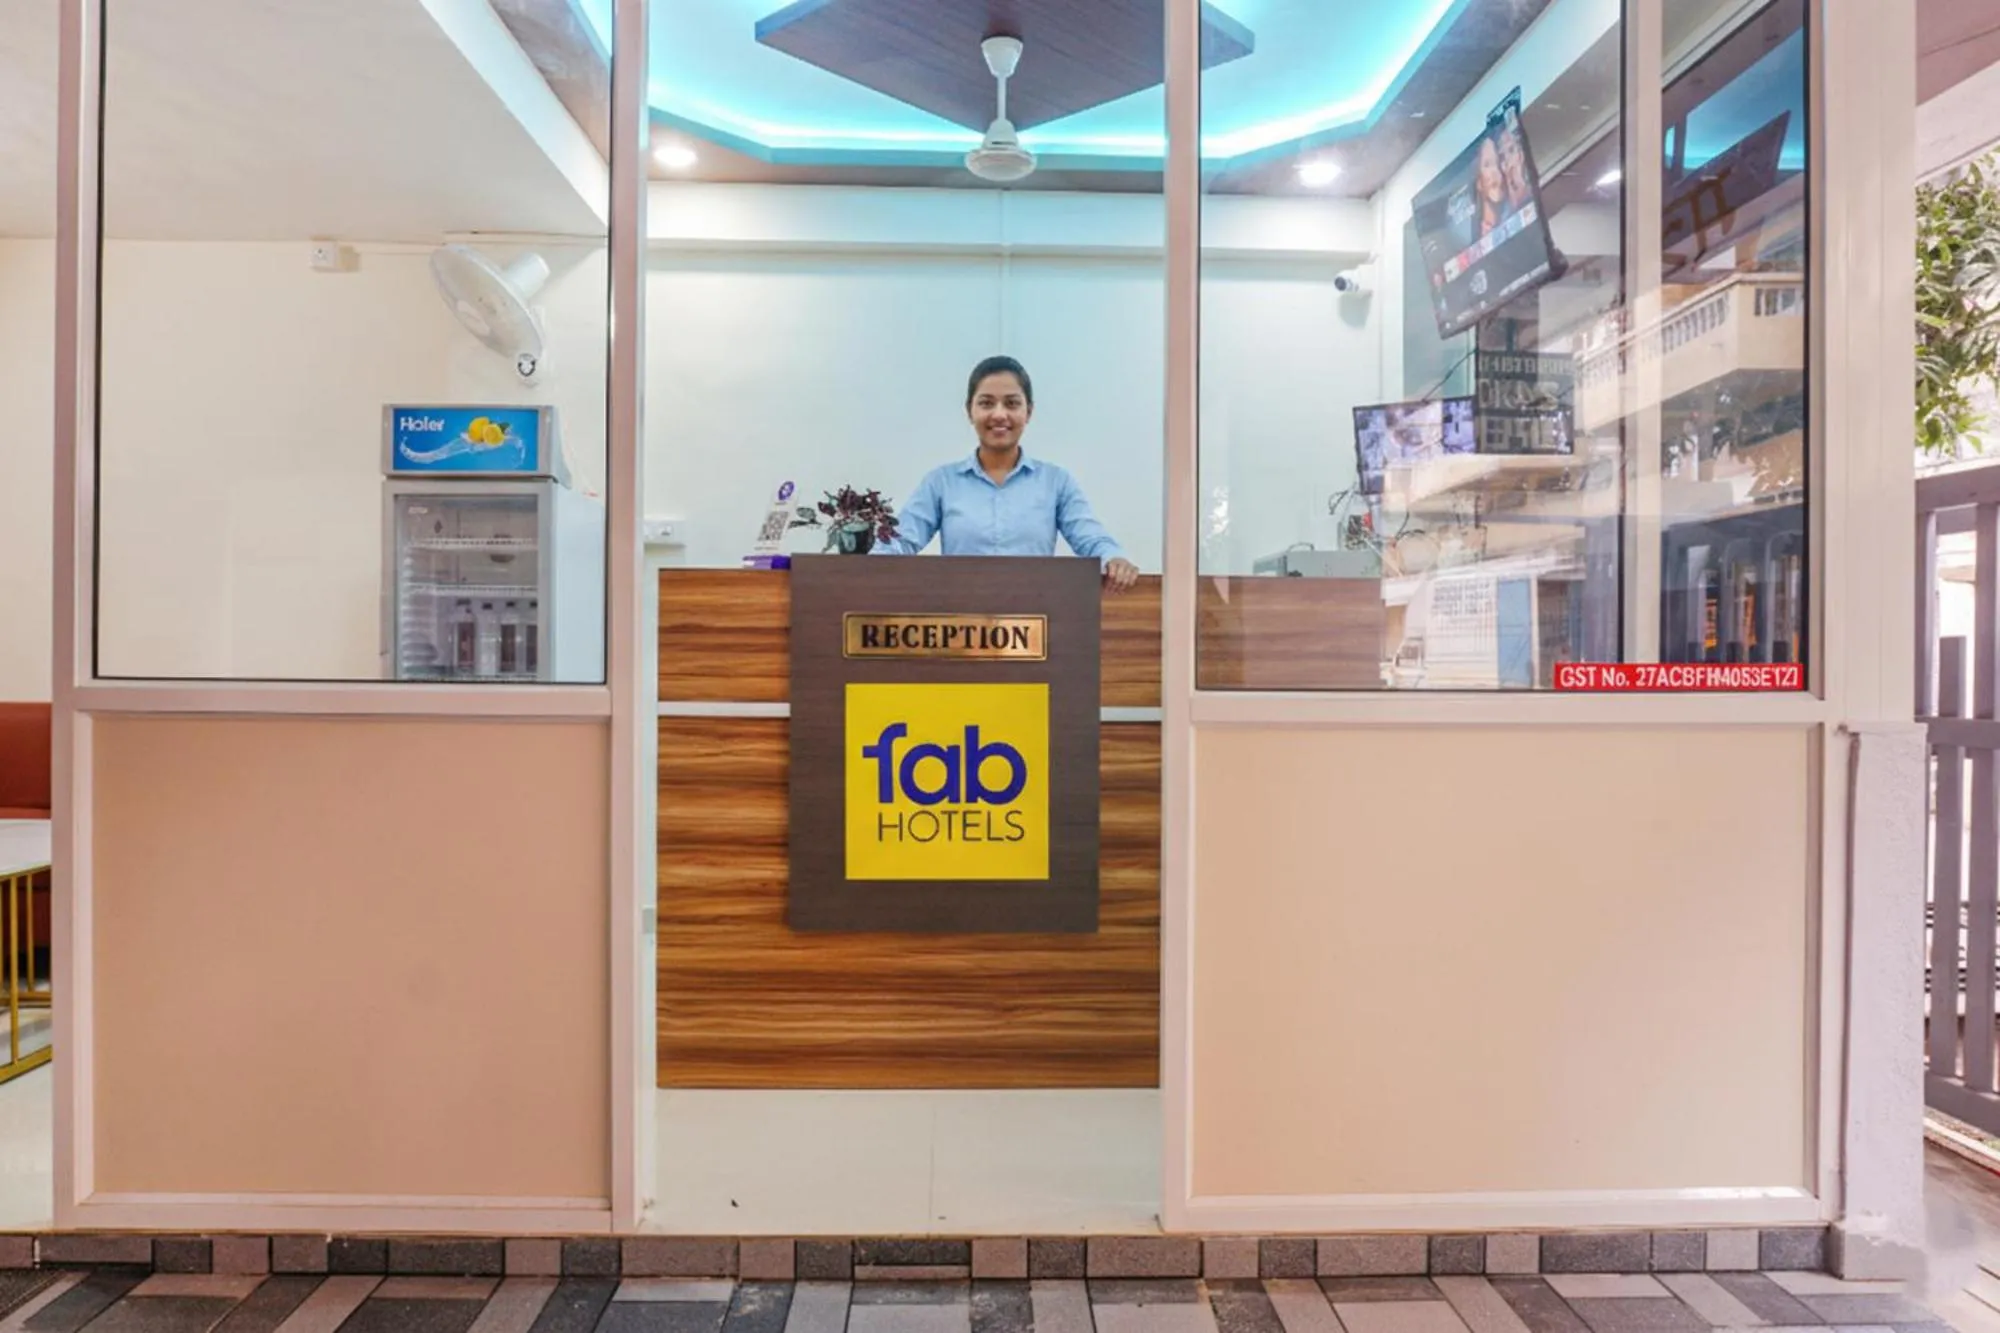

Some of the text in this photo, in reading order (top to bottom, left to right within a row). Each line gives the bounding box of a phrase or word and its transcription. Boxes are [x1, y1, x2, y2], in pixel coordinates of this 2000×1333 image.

[861, 624, 1030, 650] RECEPTION
[1560, 665, 1597, 688] GST
[1601, 665, 1631, 688] No.
[862, 722, 1028, 806] fab
[878, 809, 1025, 842] HOTELS
